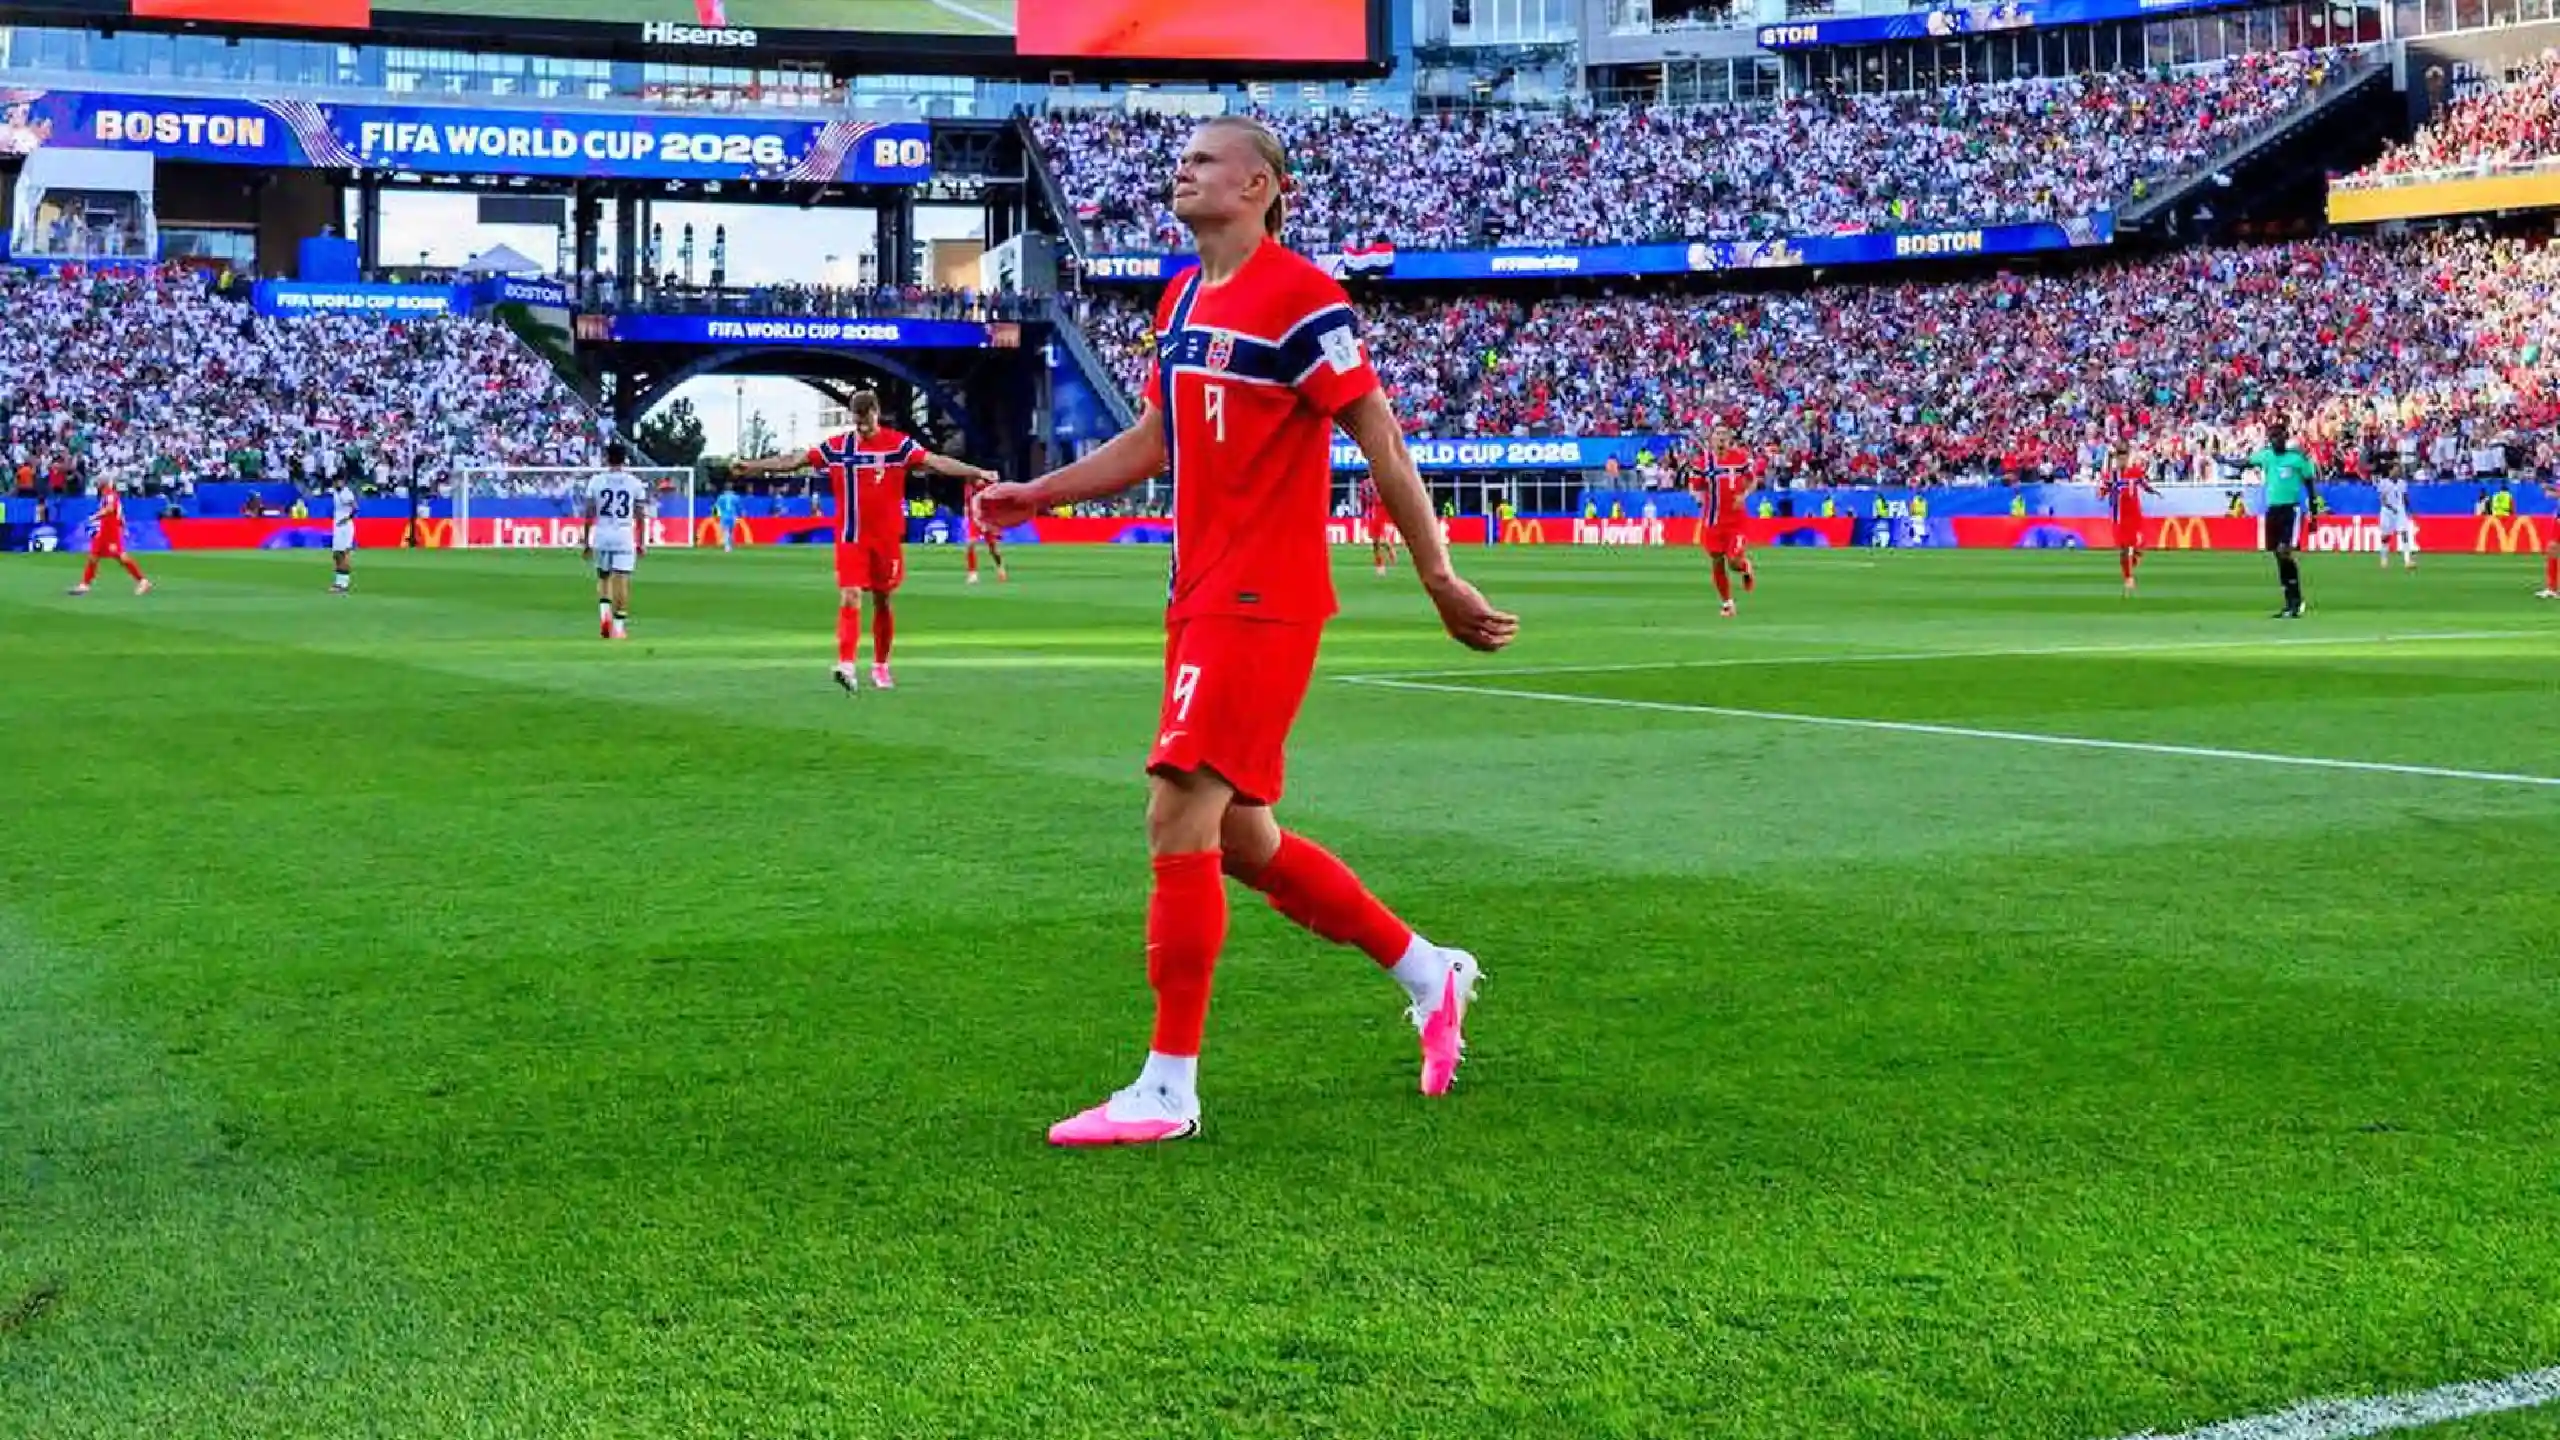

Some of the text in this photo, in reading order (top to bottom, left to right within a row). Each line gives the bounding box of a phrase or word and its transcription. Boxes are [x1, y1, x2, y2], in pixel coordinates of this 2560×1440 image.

[643, 22, 757, 46] Hisense
[95, 110, 265, 147] BOSTON
[361, 121, 786, 165] FIFA WORLD CUP 2026
[873, 139, 930, 168] BO
[1896, 230, 1982, 255] BOSTON
[1087, 258, 1160, 277] STON
[708, 321, 899, 340] FIFA WORLD CUP 2026
[1331, 442, 1581, 464] IFA RLD CUP 2026
[599, 488, 630, 519] 23
[494, 518, 542, 547] I'm
